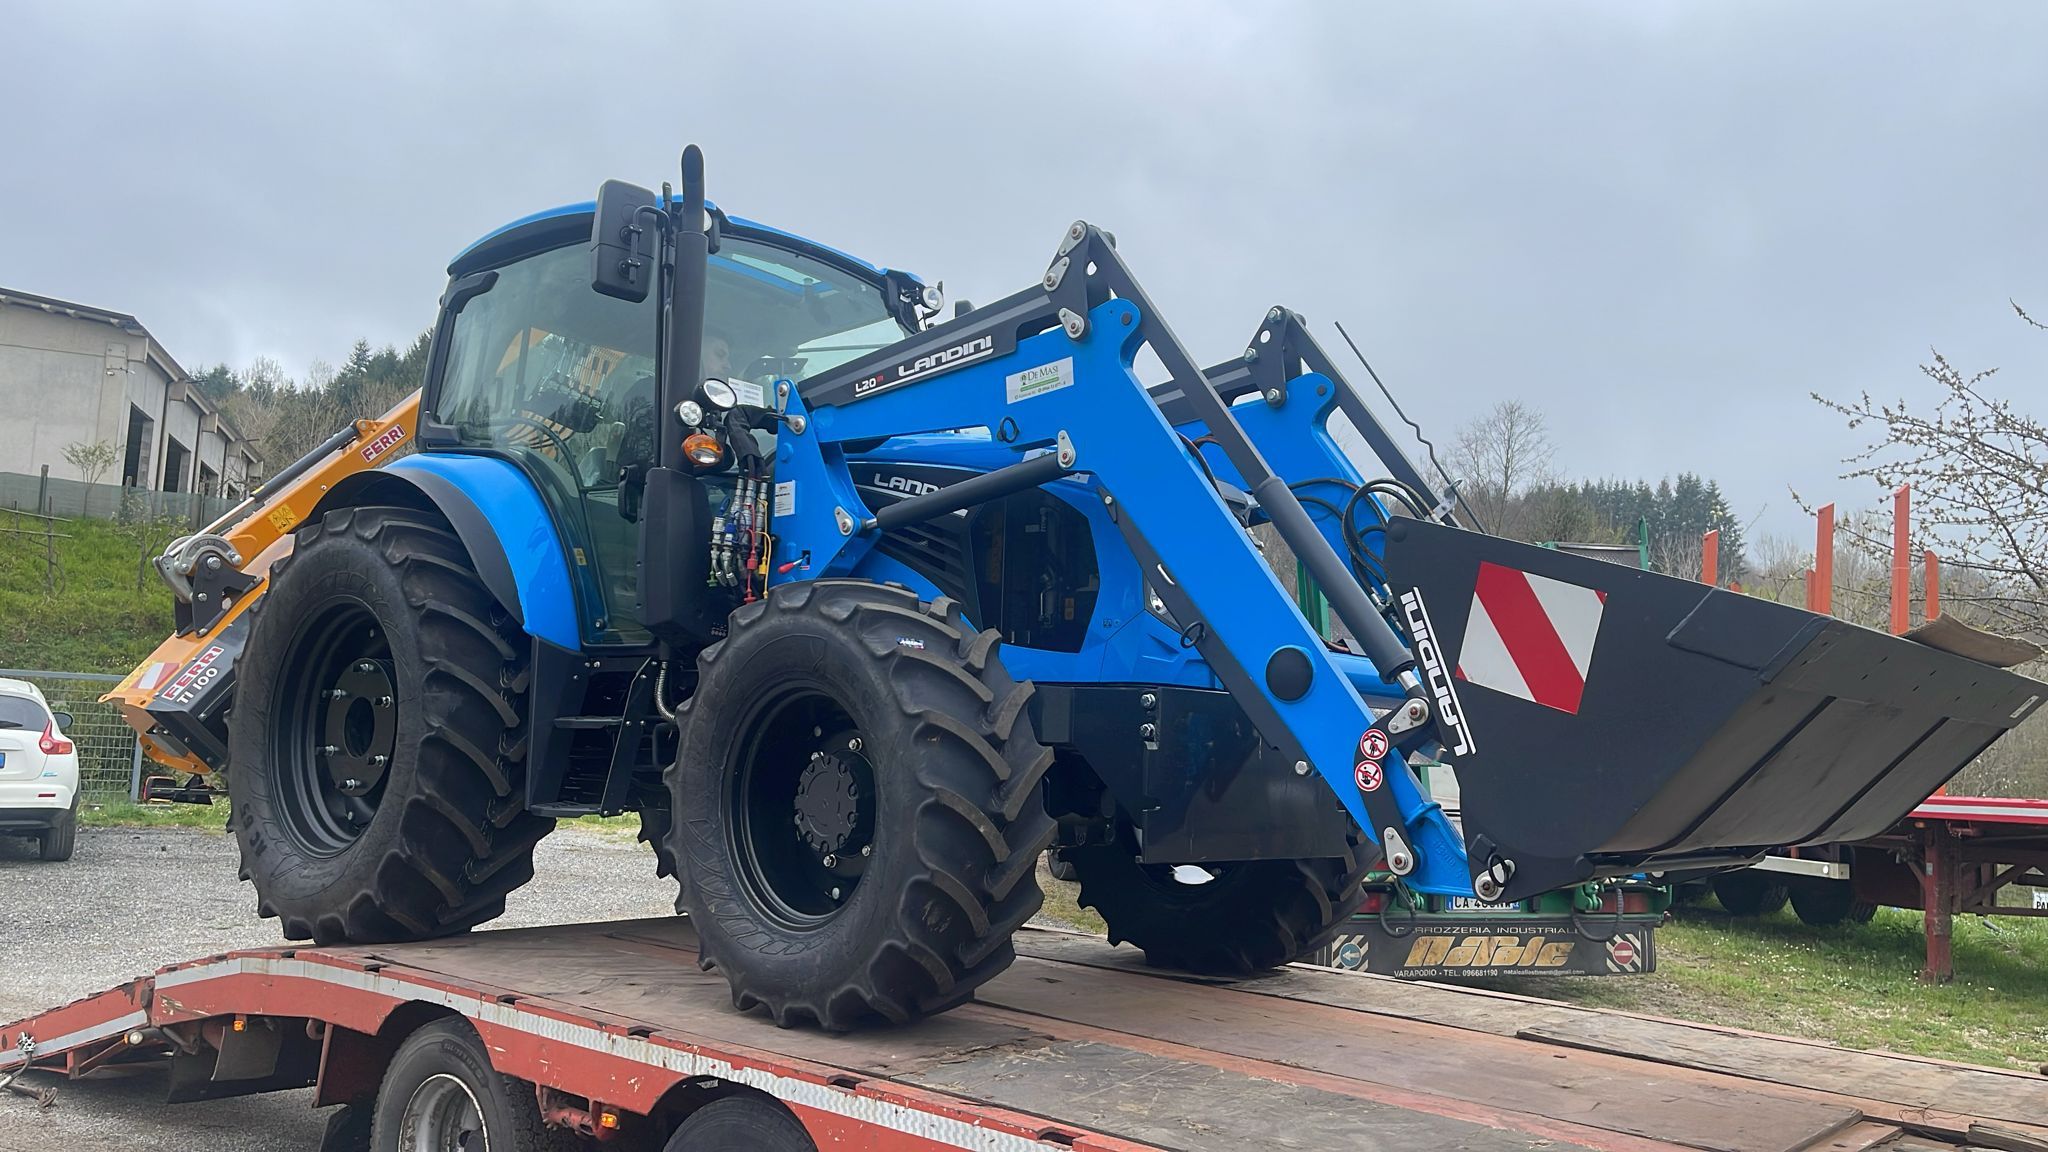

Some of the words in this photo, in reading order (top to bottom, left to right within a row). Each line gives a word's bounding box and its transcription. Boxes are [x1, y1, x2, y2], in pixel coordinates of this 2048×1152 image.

[899, 335, 992, 377] LANDINI
[362, 425, 405, 461] FERRI
[874, 473, 943, 495] LAND
[164, 647, 222, 699] FERRI
[192, 667, 218, 690] 100
[1400, 591, 1469, 757] LANDINI
[1396, 926, 1491, 934] CRROZZERIA
[1394, 968, 1437, 978] VARAPODIO
[1443, 969, 1461, 977] TEL.
[1462, 968, 1498, 977] 096681190
